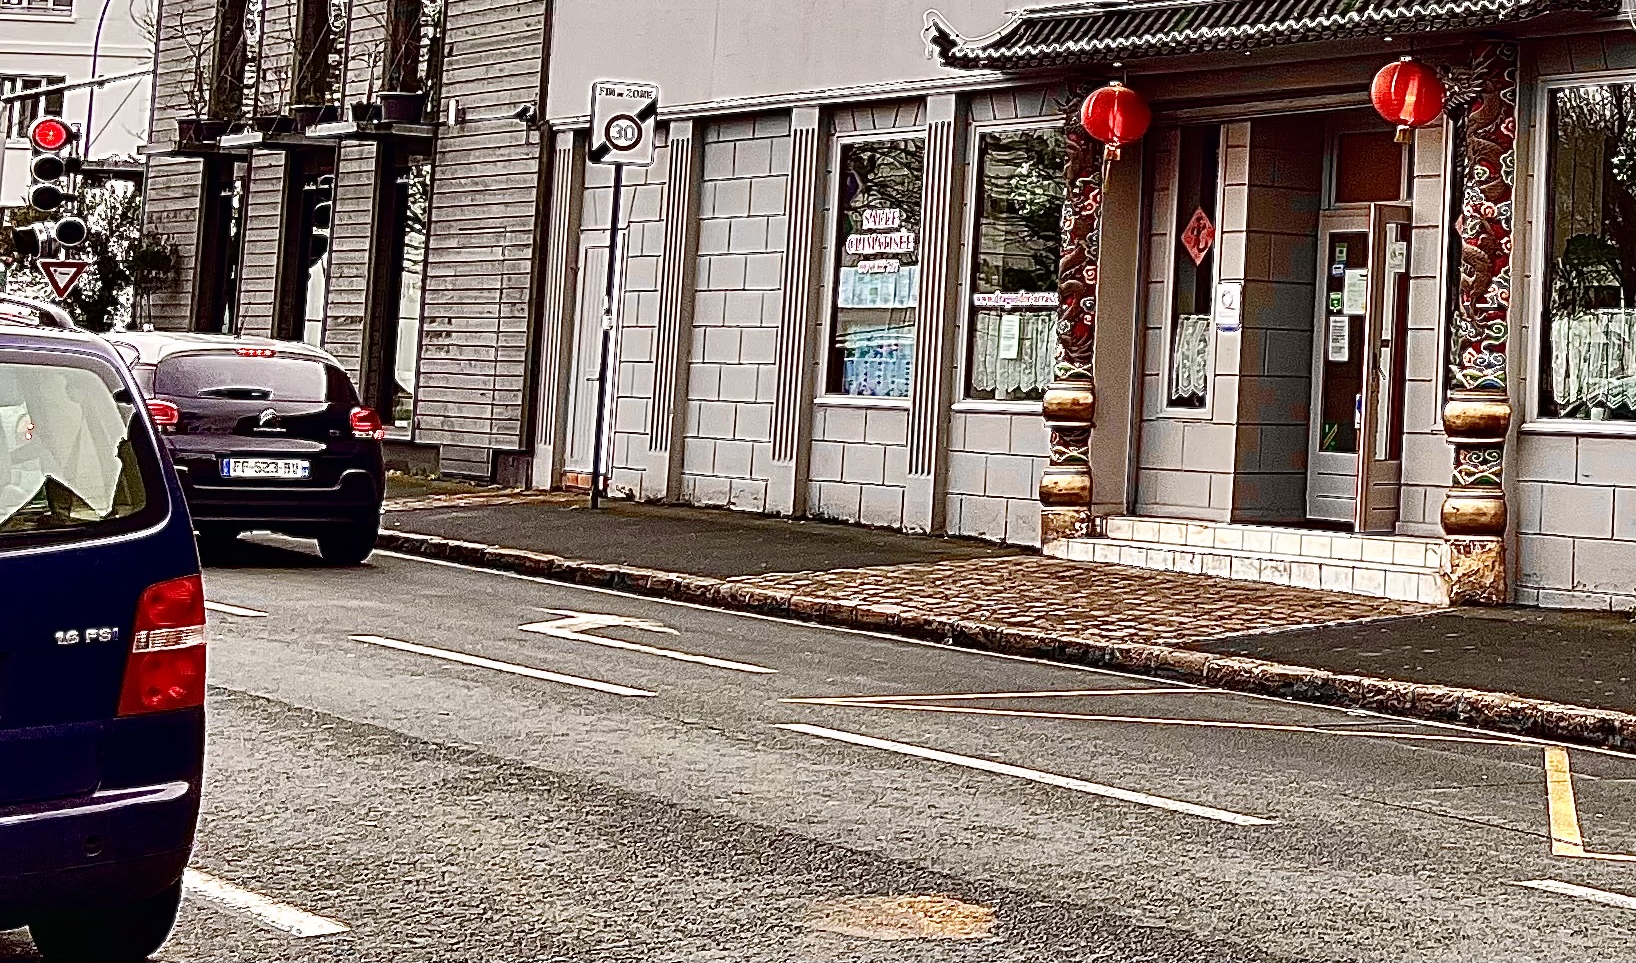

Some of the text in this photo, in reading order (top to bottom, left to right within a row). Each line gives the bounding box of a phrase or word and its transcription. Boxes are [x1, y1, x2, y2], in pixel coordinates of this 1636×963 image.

[598, 86, 616, 97] FIN
[625, 88, 654, 100] ZONE
[611, 123, 636, 142] 30
[85, 627, 119, 643] FSI
